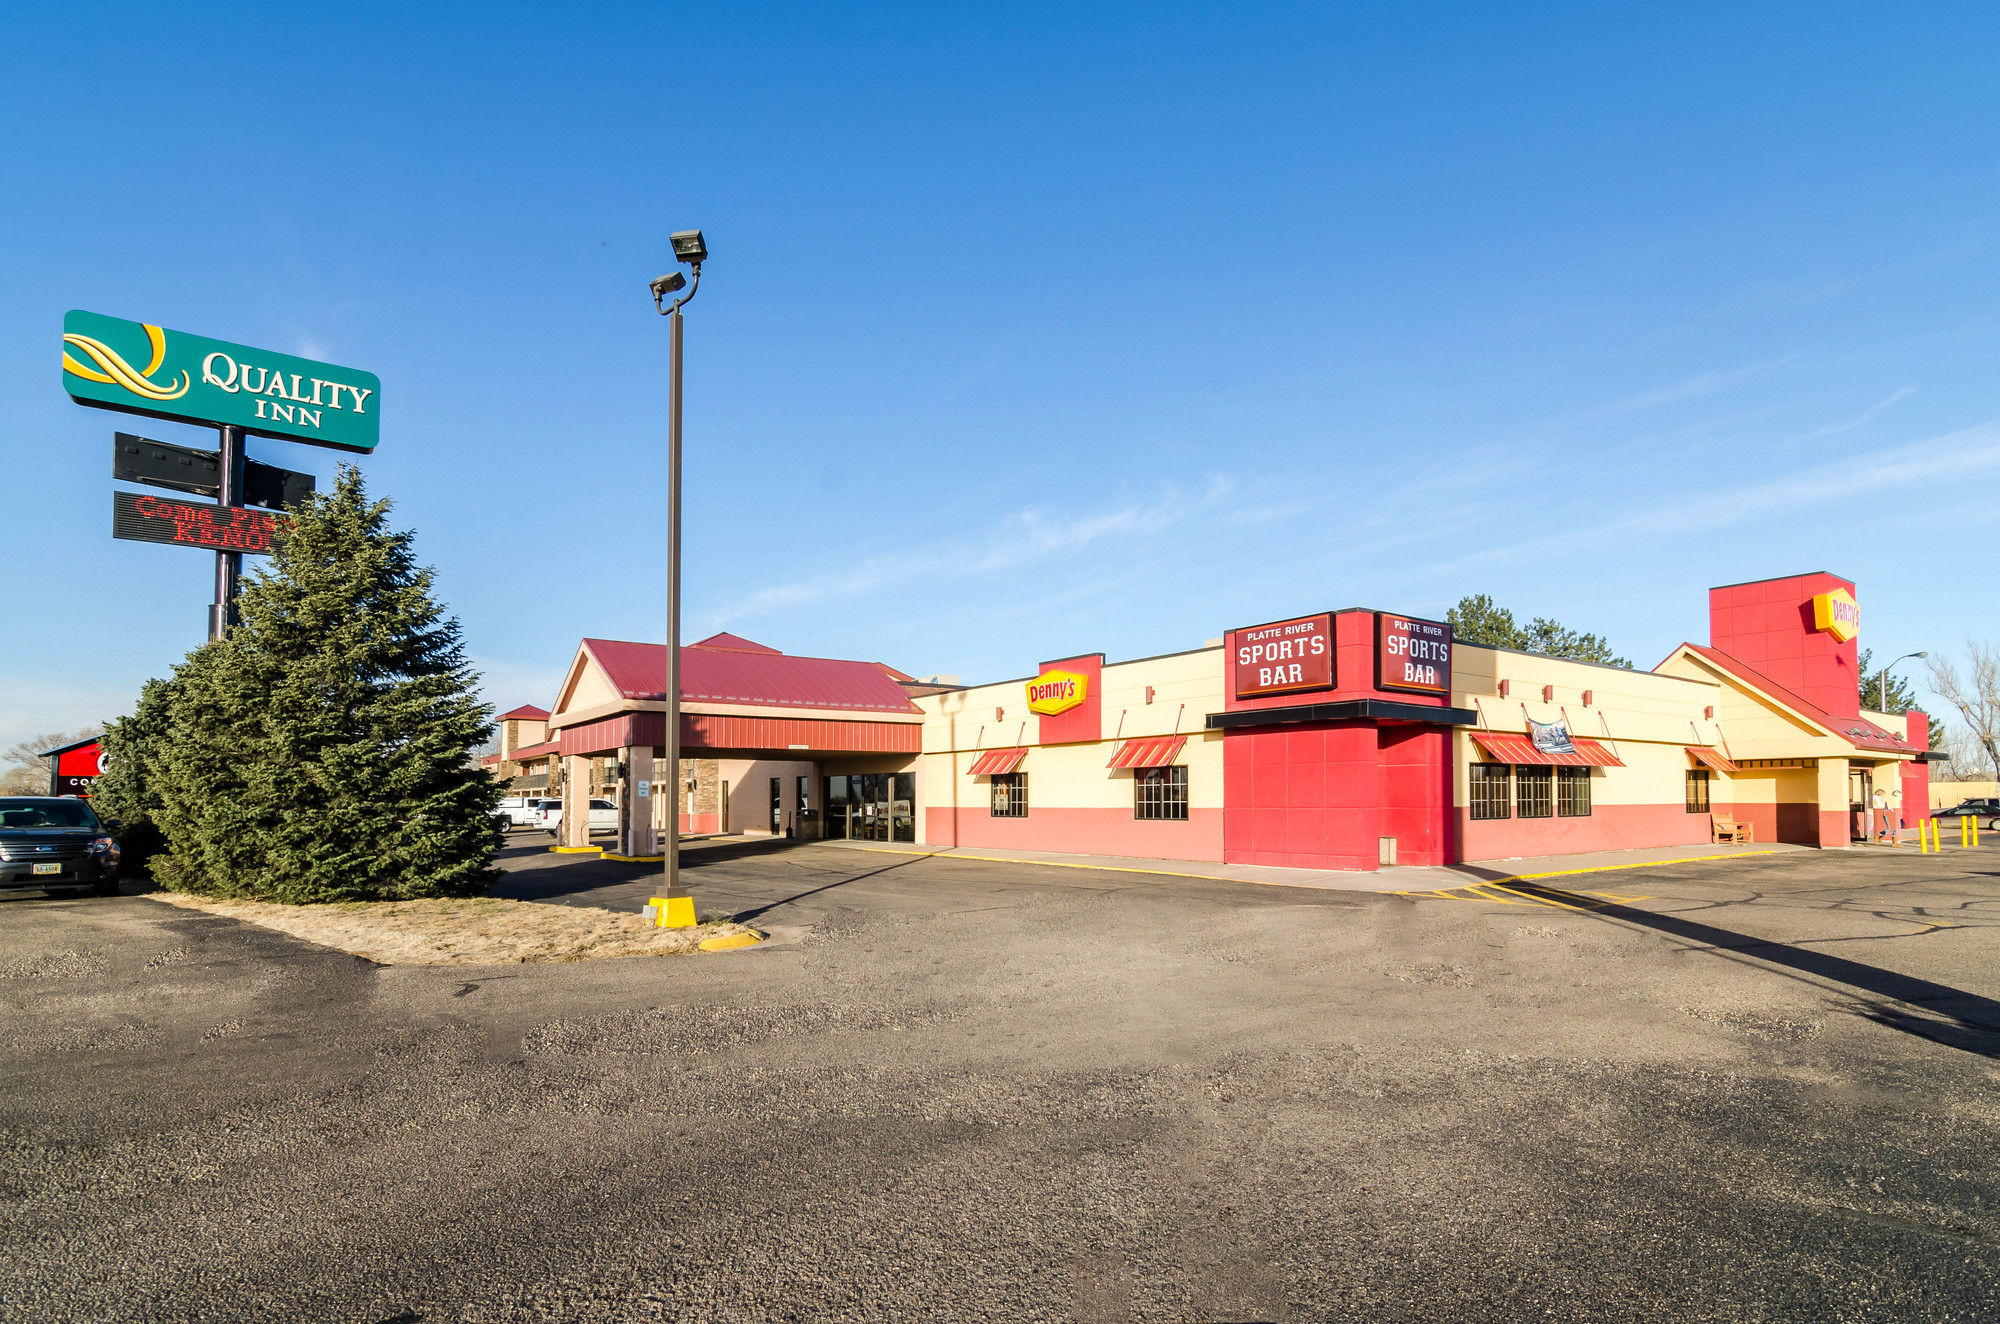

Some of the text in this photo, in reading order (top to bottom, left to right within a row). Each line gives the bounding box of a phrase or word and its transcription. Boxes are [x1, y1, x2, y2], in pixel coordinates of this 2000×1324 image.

[202, 353, 372, 414] QUALITY
[255, 399, 322, 429] INN
[136, 496, 213, 524] Come
[1832, 599, 1860, 628] Denny's
[1247, 622, 1314, 642] PLATTE RIVER
[1394, 620, 1442, 636] PLATTE RIVER
[1239, 634, 1325, 665] SPORTS
[1387, 635, 1448, 662] SPORTS
[1259, 663, 1303, 687] BAR
[1403, 662, 1435, 685] BAR
[1029, 678, 1076, 704] Denny's
